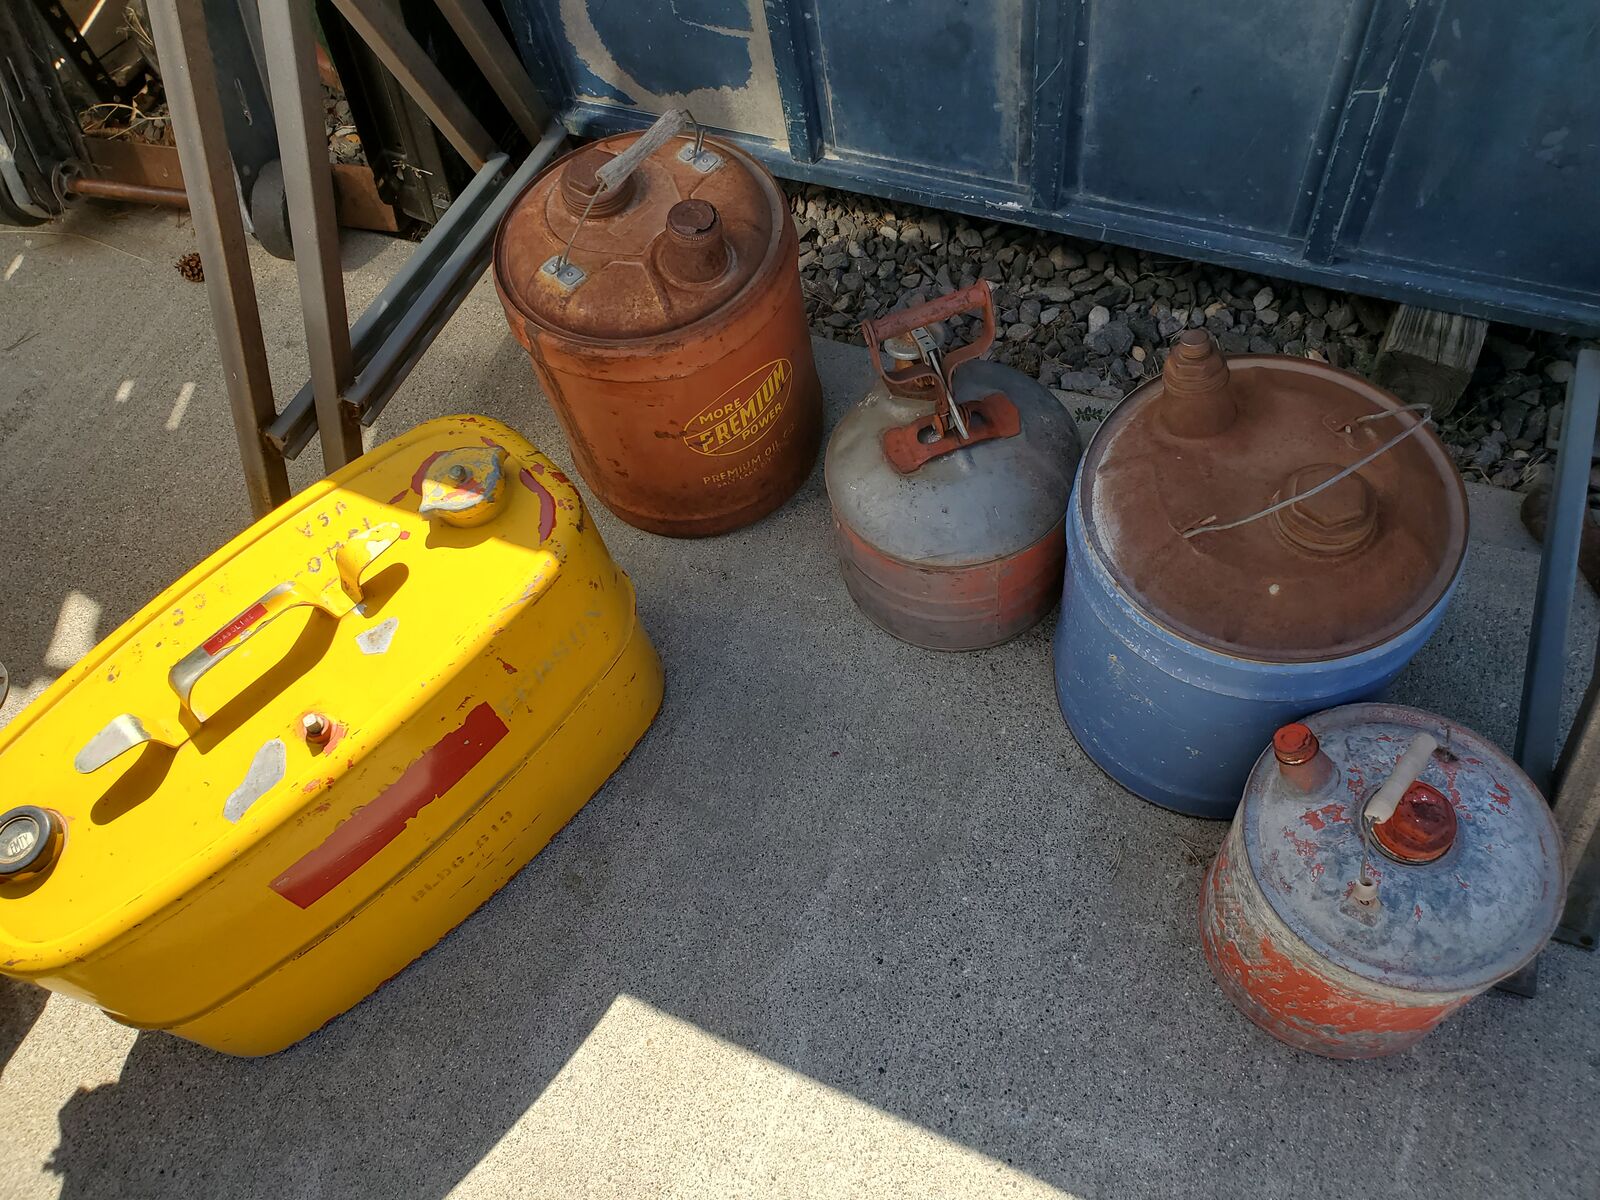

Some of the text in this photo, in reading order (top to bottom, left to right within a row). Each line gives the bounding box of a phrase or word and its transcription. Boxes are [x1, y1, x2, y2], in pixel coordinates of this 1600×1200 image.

[699, 361, 785, 453] PREMIUM
[699, 397, 742, 425] MORE
[741, 402, 782, 441] POWER
[703, 454, 761, 485] PREMIUM
[764, 440, 780, 457] OIL
[216, 610, 254, 643] GASOLINE
